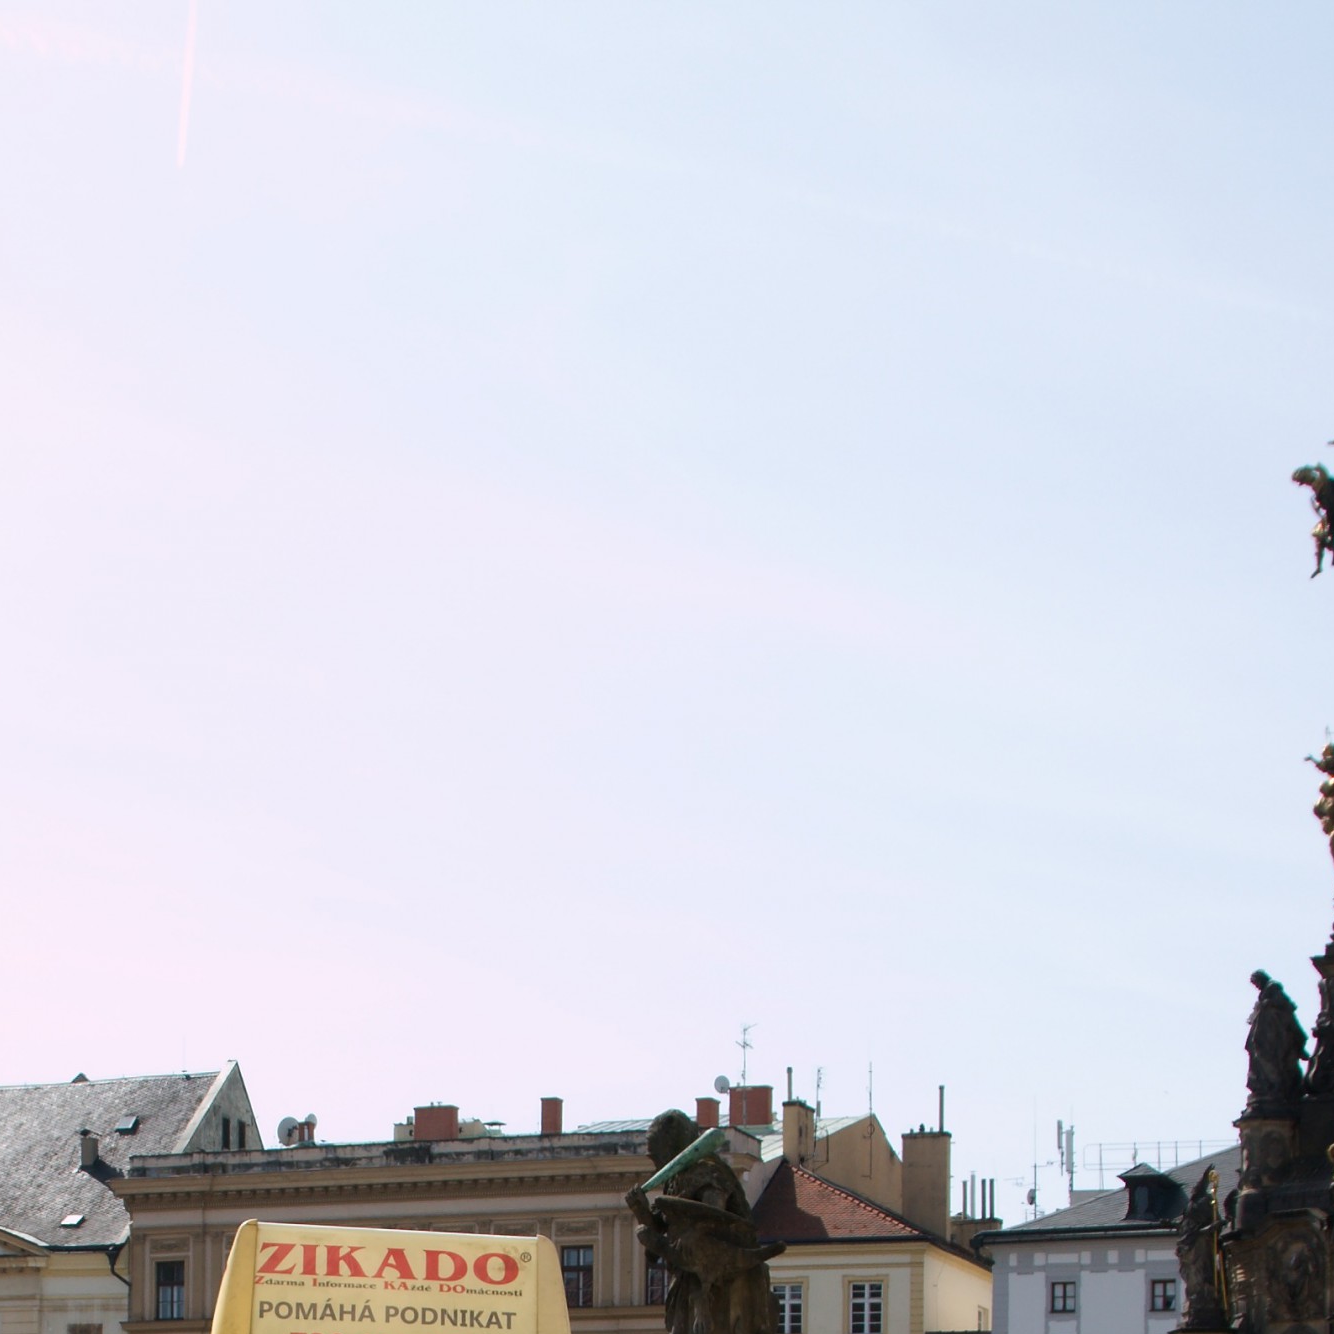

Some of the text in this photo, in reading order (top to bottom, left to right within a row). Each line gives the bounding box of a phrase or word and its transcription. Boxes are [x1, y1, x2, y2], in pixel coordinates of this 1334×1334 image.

[257, 1242, 520, 1285] ZIKADO
[255, 1275, 305, 1287] Zdarma
[312, 1278, 377, 1290] Informace
[259, 1298, 517, 1330] POMÁHÁ PODNIKAT
